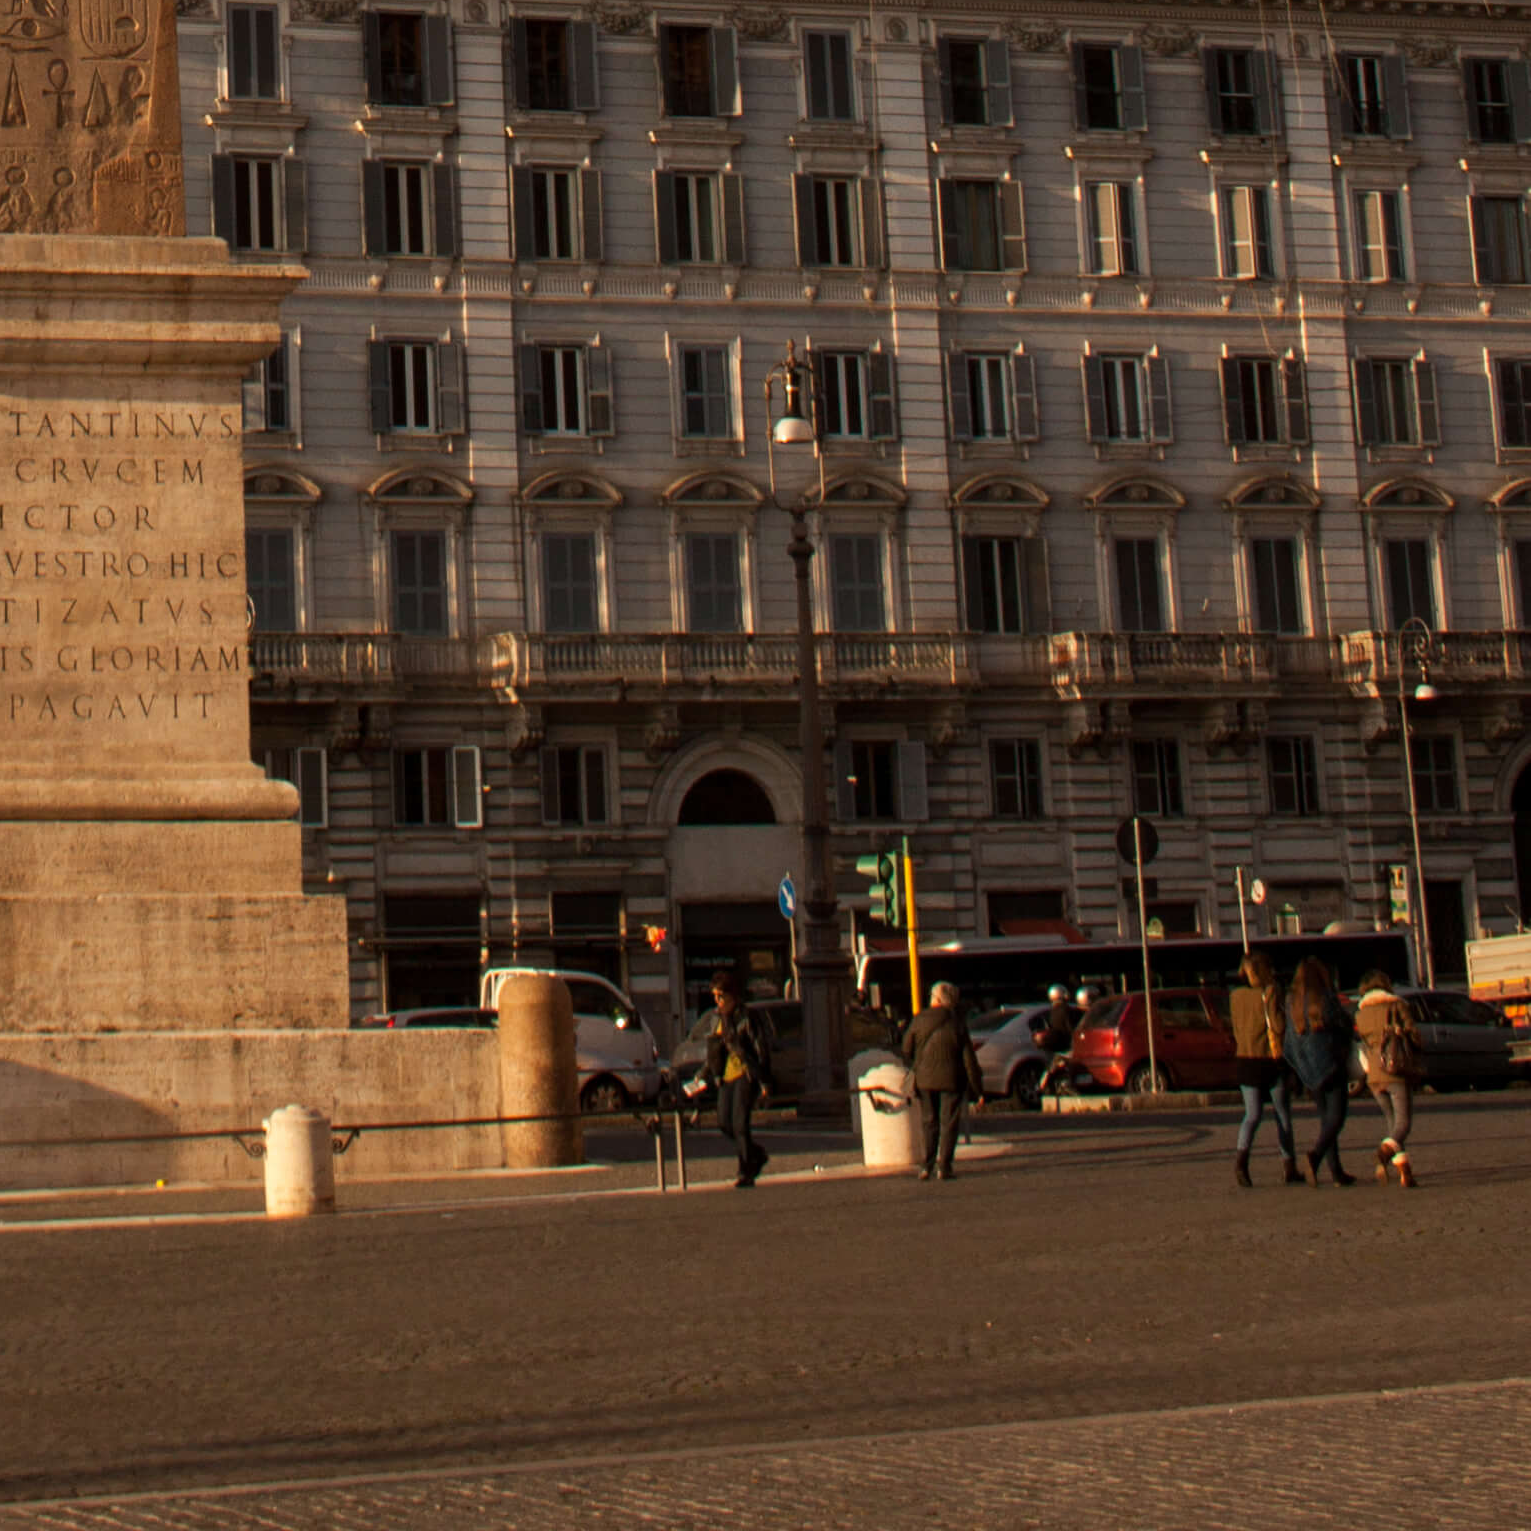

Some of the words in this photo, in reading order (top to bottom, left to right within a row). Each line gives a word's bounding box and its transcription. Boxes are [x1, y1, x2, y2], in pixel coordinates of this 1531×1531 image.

[14, 457, 206, 485] CRVCEM
[169, 552, 239, 579] HIC
[56, 645, 241, 672] GLORIAM
